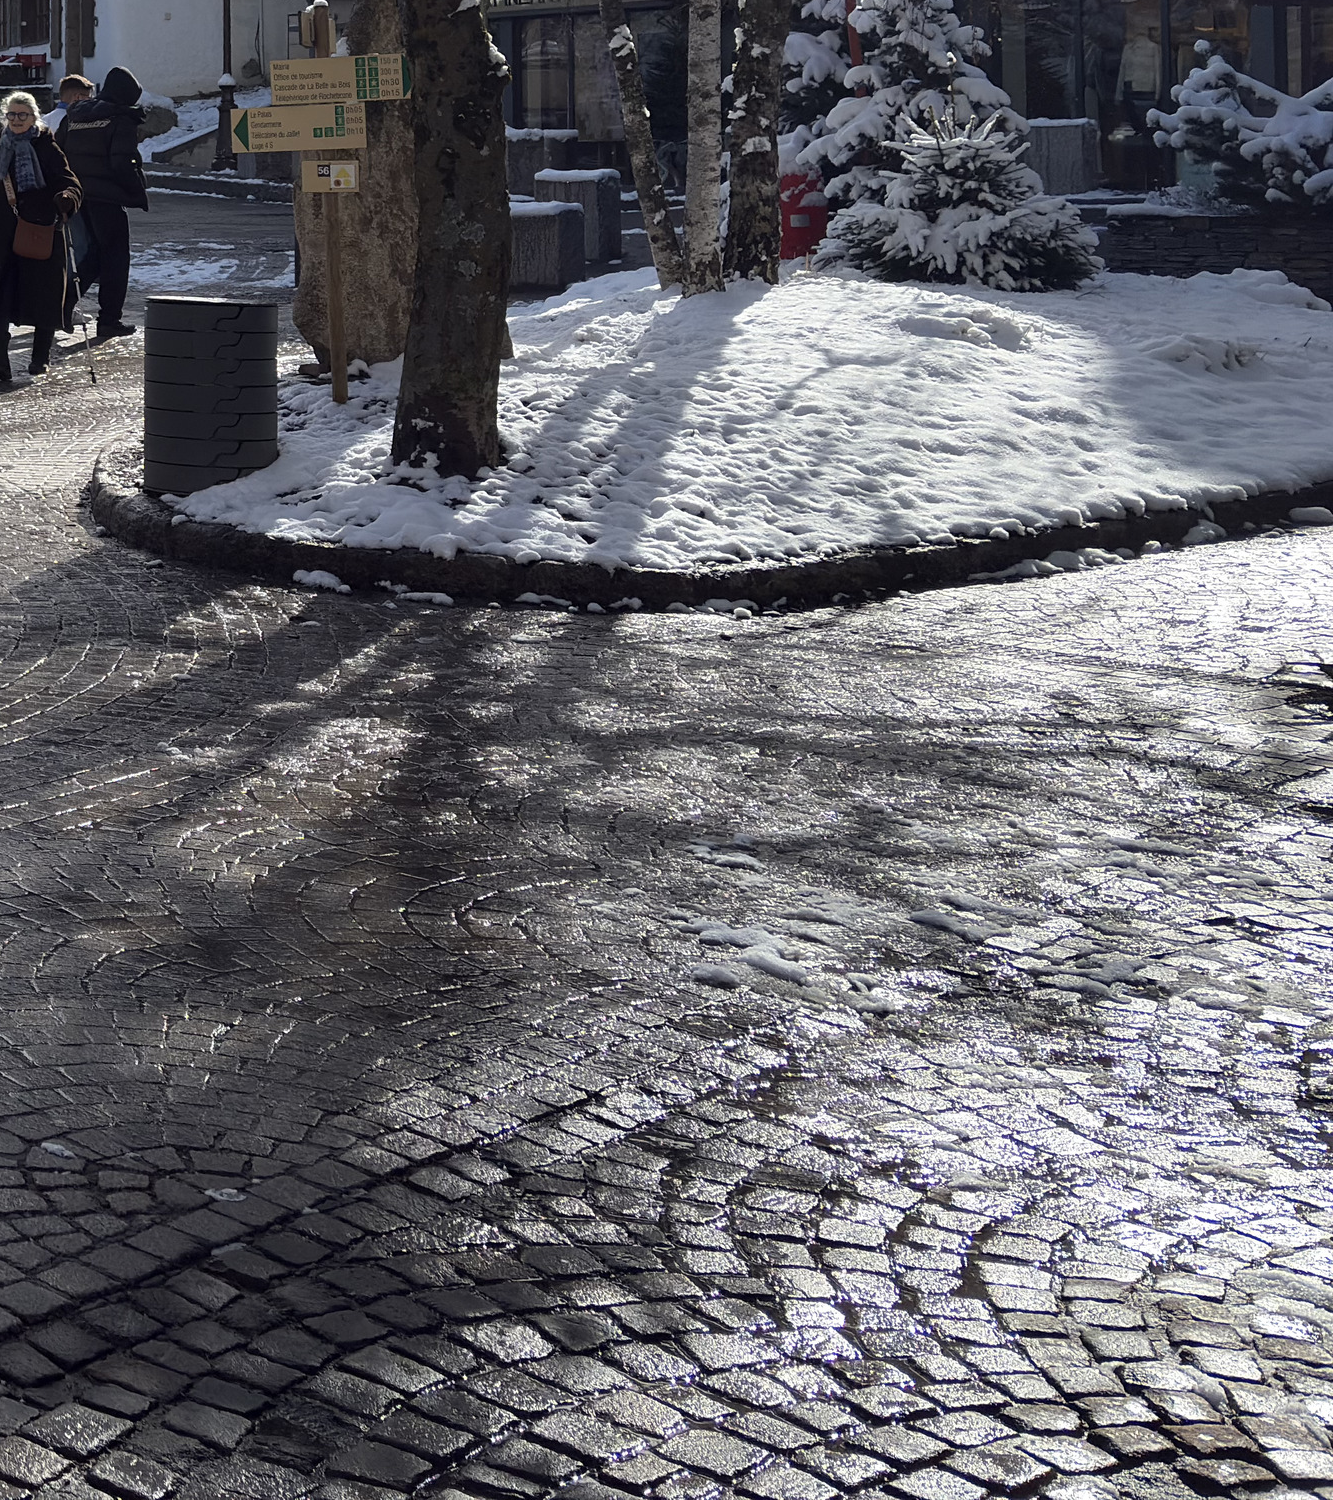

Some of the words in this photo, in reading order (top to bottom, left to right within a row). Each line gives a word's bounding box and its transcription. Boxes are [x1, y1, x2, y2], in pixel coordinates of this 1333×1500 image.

[273, 63, 290, 71] Mairie
[273, 73, 290, 81] Office
[290, 72, 298, 80] de
[299, 72, 323, 80] tourisme
[274, 83, 298, 92] Cascade
[380, 78, 400, 86] 0h30
[345, 105, 363, 114] 0h05
[345, 116, 363, 125] 0h05
[346, 127, 364, 135] 0h10
[318, 166, 330, 175] 56
